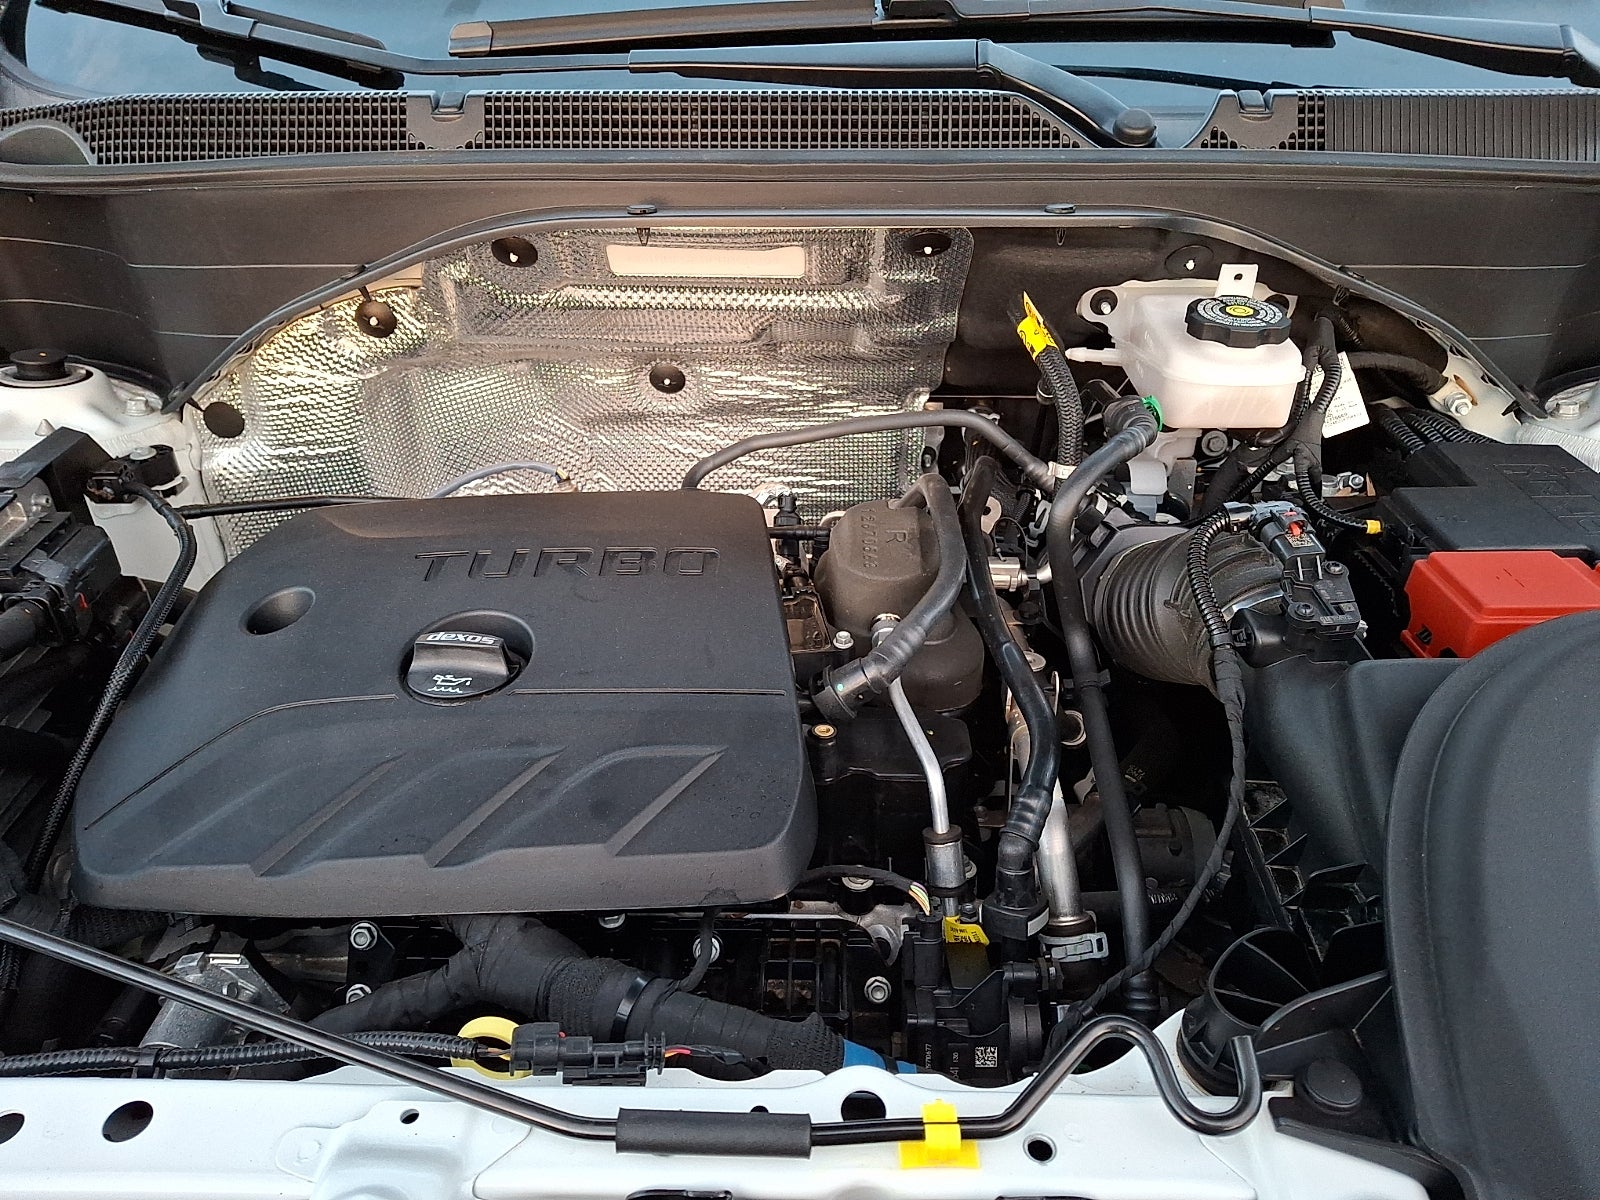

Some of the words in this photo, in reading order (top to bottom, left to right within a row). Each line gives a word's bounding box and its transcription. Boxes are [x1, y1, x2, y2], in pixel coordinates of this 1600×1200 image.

[885, 529, 908, 544] R
[415, 547, 720, 581] TURBO
[426, 631, 496, 646] dexos
